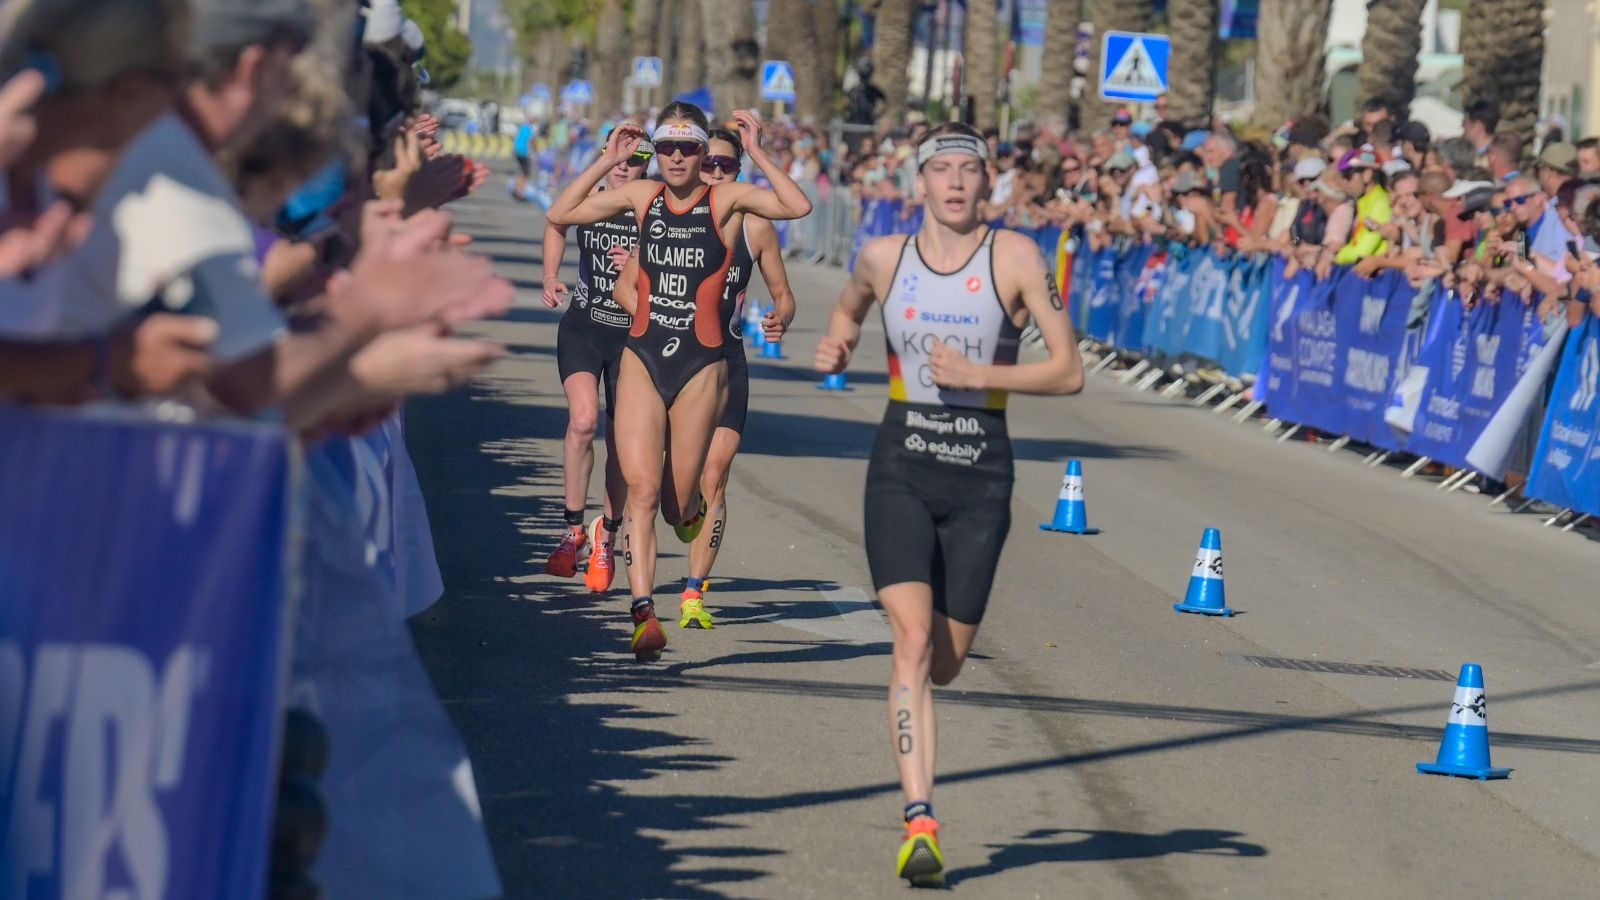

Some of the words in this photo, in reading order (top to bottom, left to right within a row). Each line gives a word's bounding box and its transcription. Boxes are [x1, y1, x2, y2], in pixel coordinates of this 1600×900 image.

[647, 243, 705, 268] KLAMER
[658, 271, 687, 297] NED
[648, 294, 697, 310] KOGA
[594, 310, 629, 323] PRECISION
[649, 311, 692, 326] squirt
[920, 311, 980, 325] SUZUKI
[927, 442, 982, 463] edubily
[709, 519, 722, 549] 28
[624, 534, 633, 567] 19
[898, 709, 912, 754] 20
